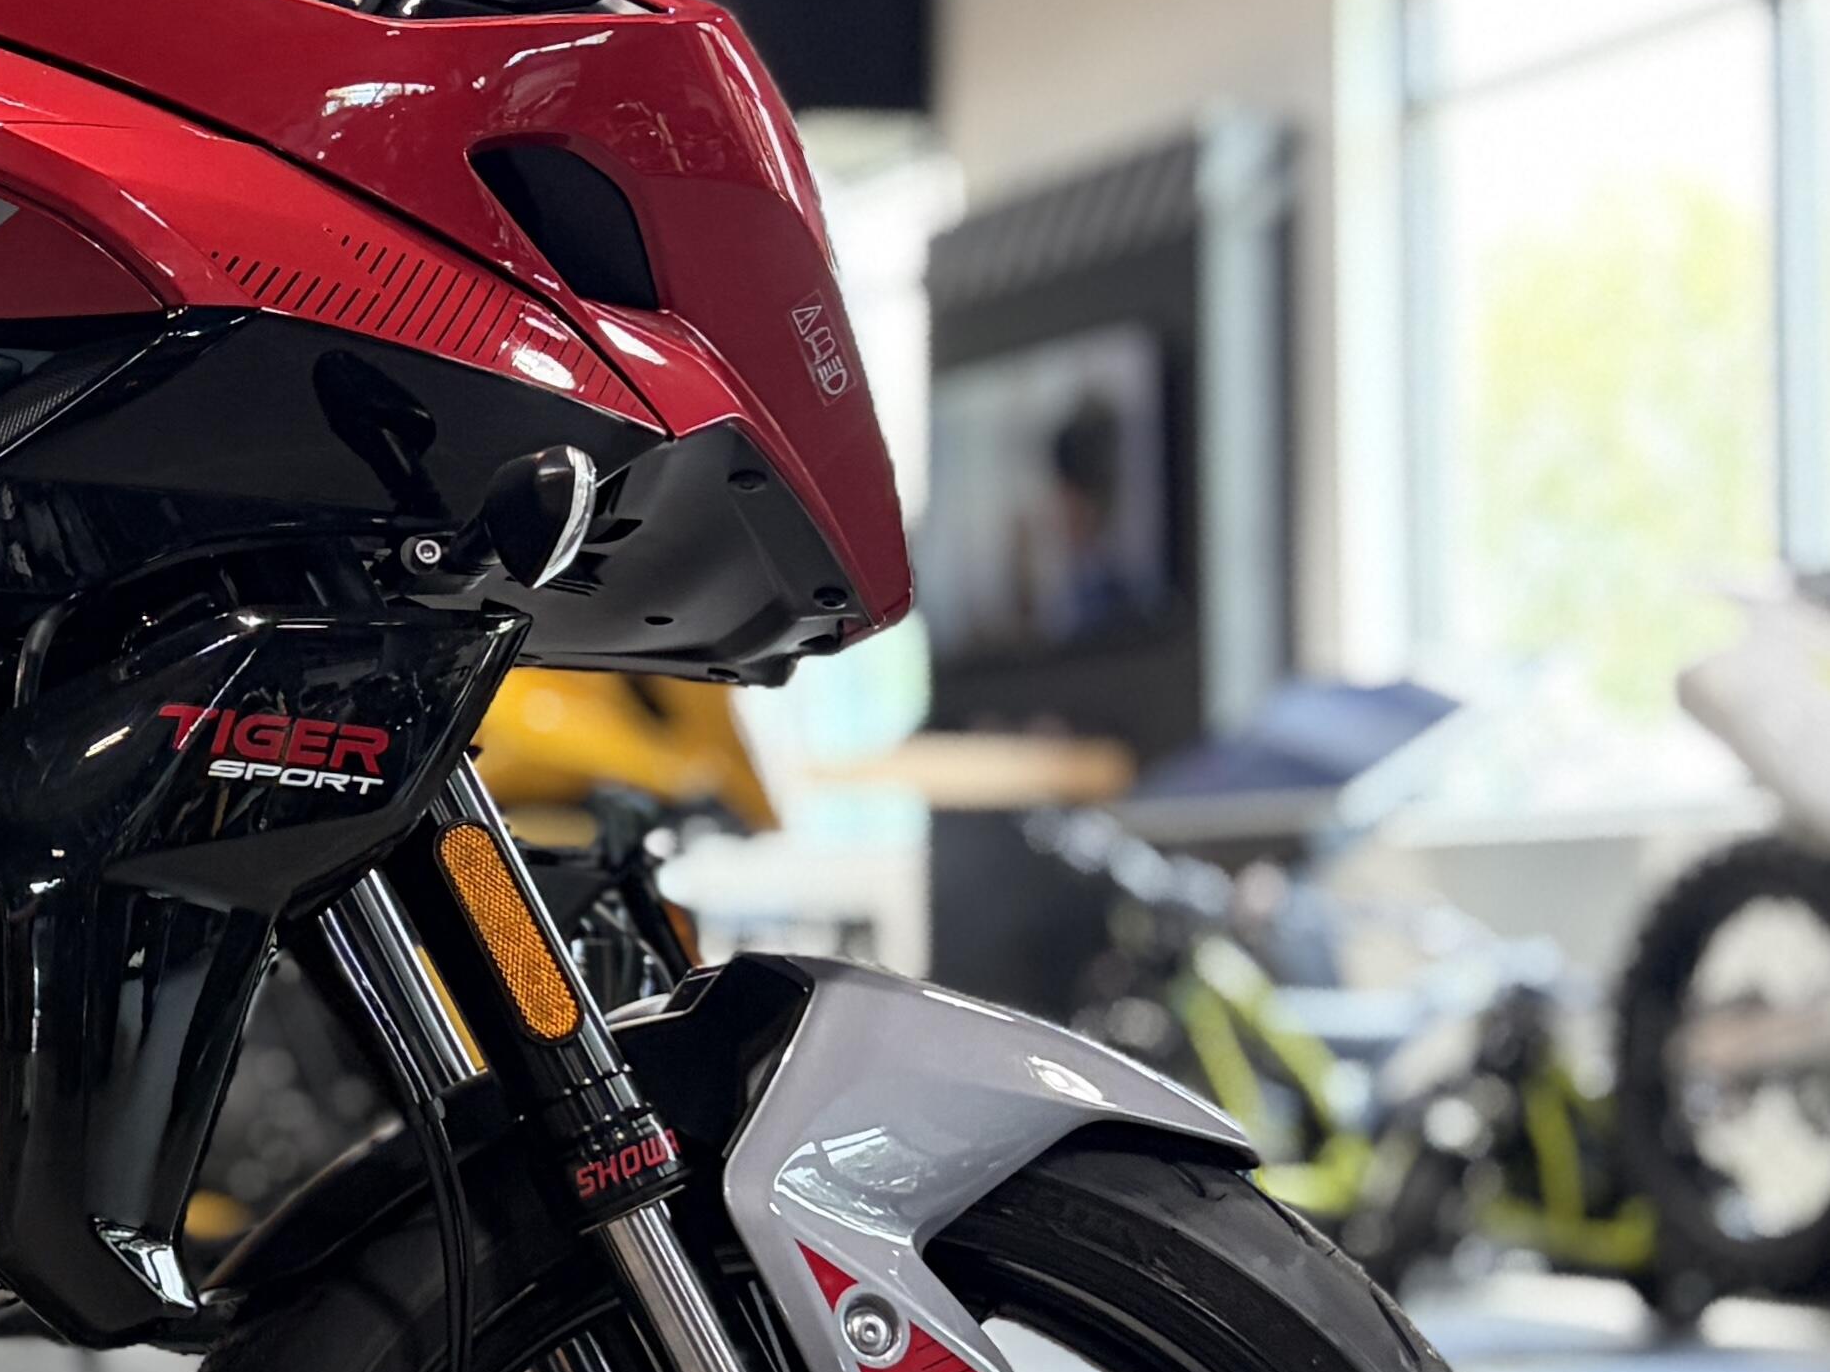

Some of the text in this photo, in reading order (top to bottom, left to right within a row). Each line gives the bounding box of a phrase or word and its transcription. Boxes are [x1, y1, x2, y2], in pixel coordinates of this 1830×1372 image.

[161, 704, 391, 773] TIGER
[208, 759, 384, 795] SPORT
[575, 1128, 681, 1198] SHOWA
